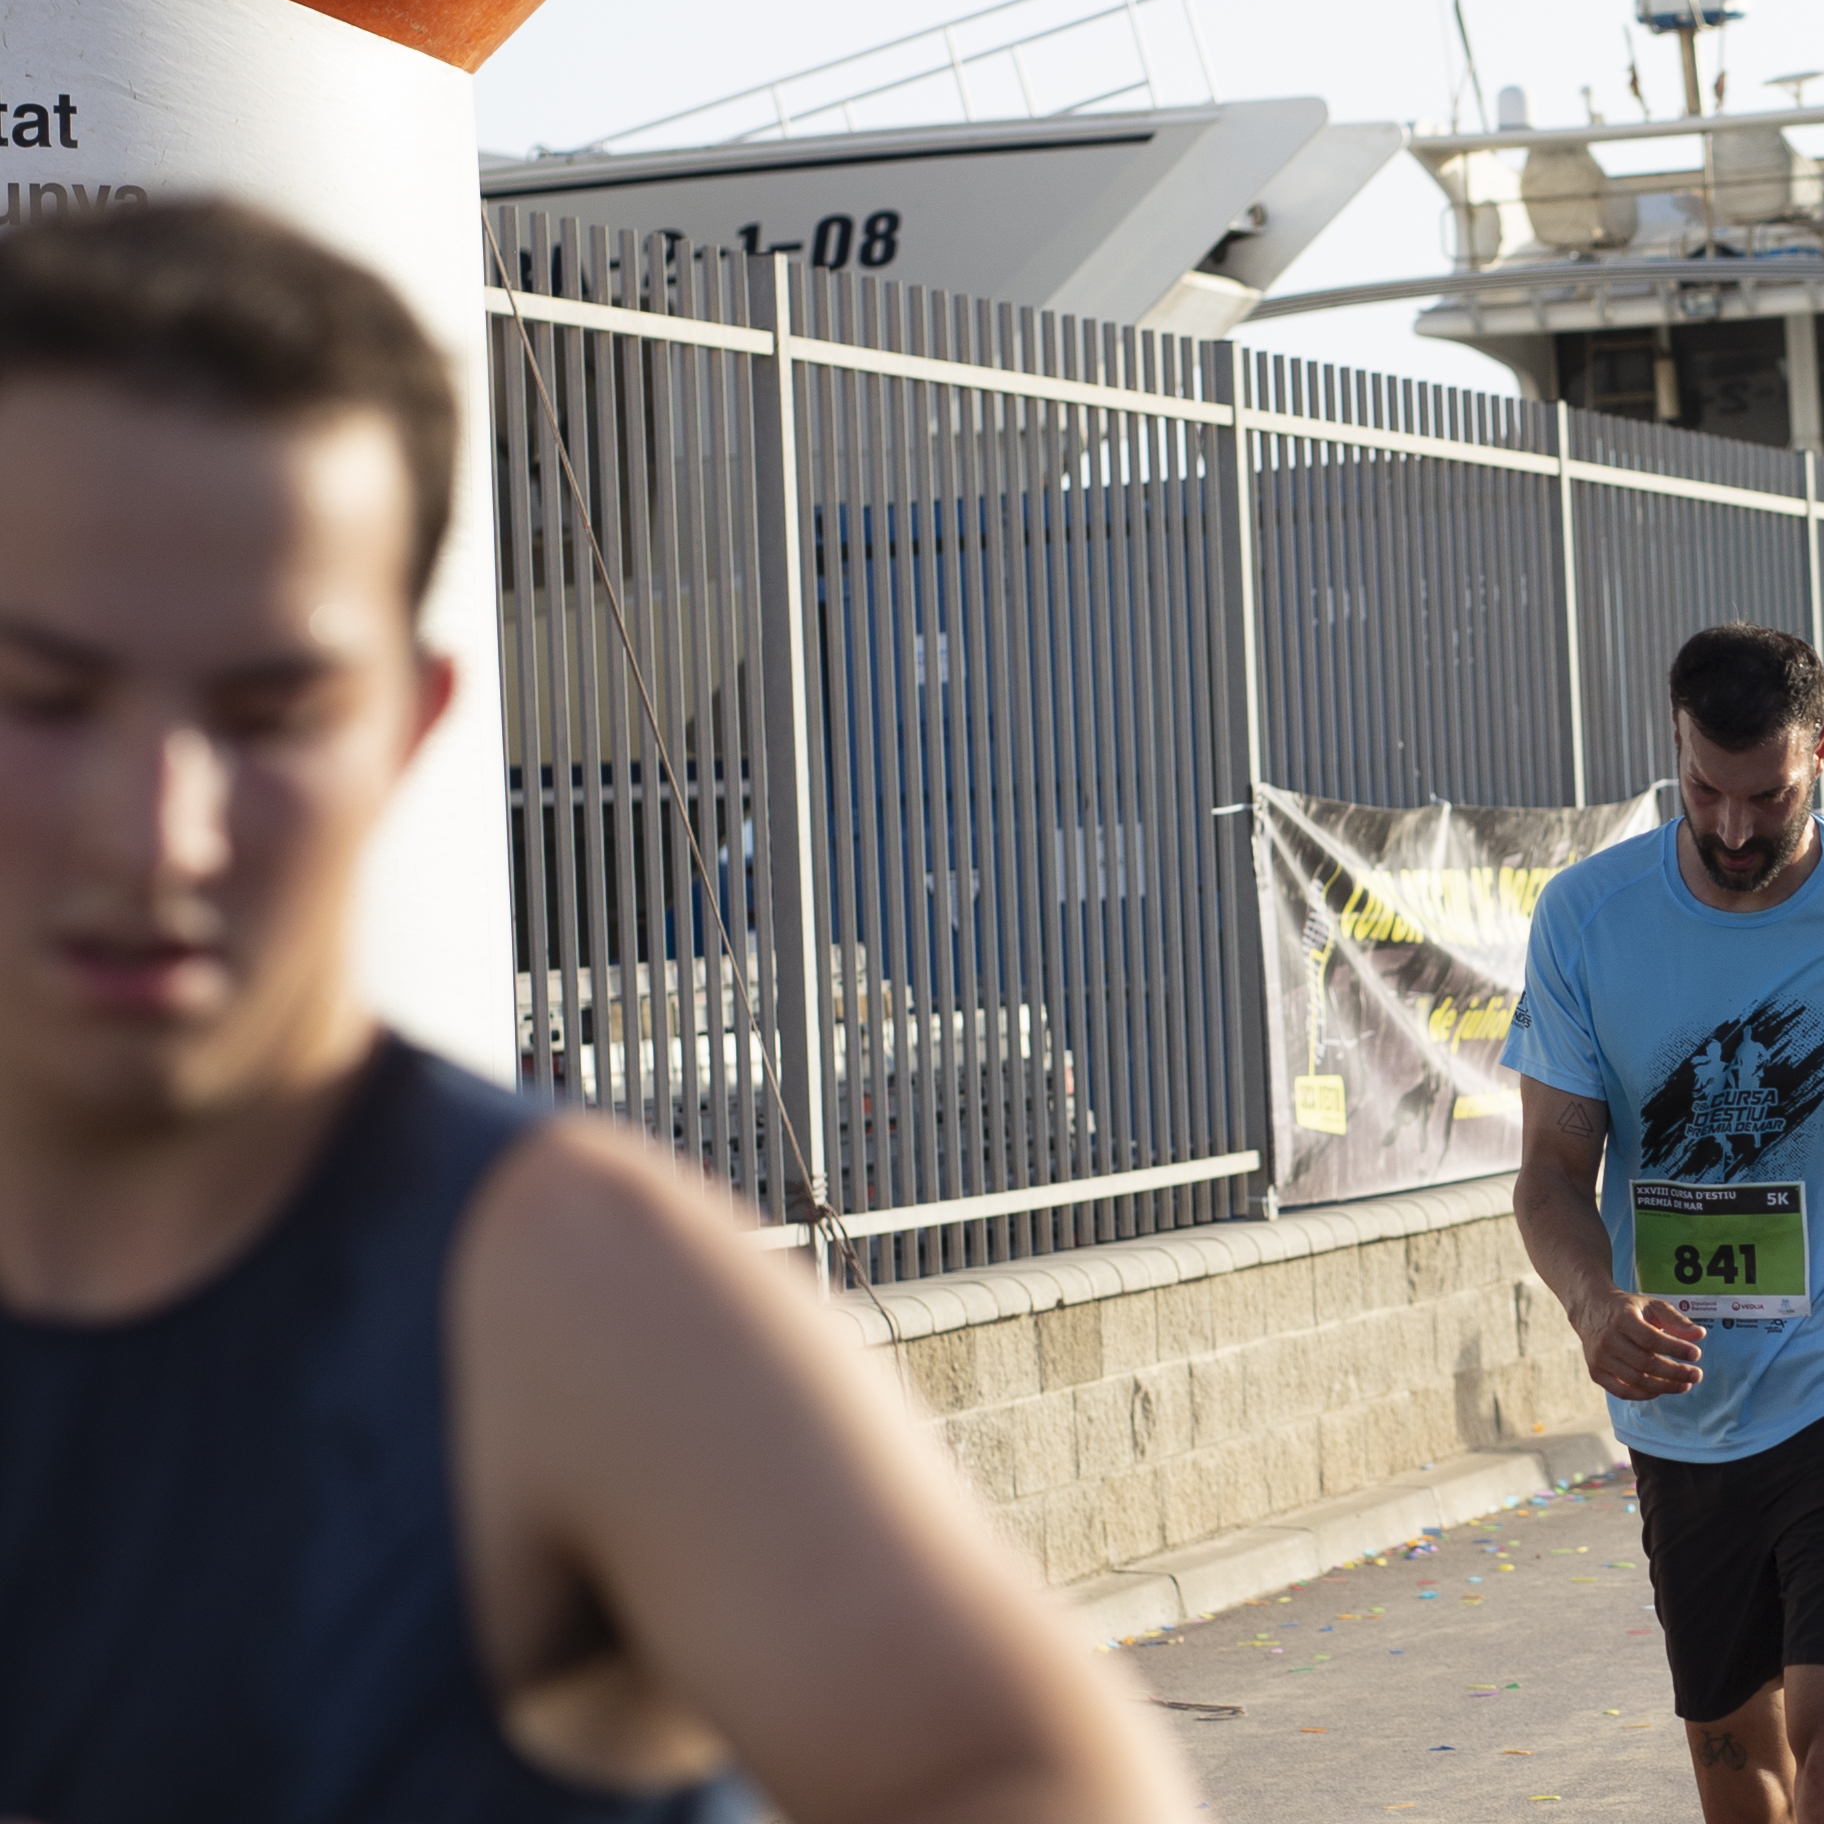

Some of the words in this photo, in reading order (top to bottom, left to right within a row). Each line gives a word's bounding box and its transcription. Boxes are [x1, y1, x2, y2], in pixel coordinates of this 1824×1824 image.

[1710, 1090, 1777, 1107] CURSA
[1734, 1121, 1752, 1132] DE
[1752, 1118, 1784, 1133] MAR
[1636, 1186, 1669, 1197] XXVIII
[1670, 1188, 1693, 1200] CURSA
[1695, 1190, 1737, 1201] D'ESTIU
[1766, 1191, 1790, 1206] 5K
[1673, 1199, 1683, 1209] DE
[1683, 1200, 1704, 1211] MAR
[1673, 1243, 1757, 1285] 841
